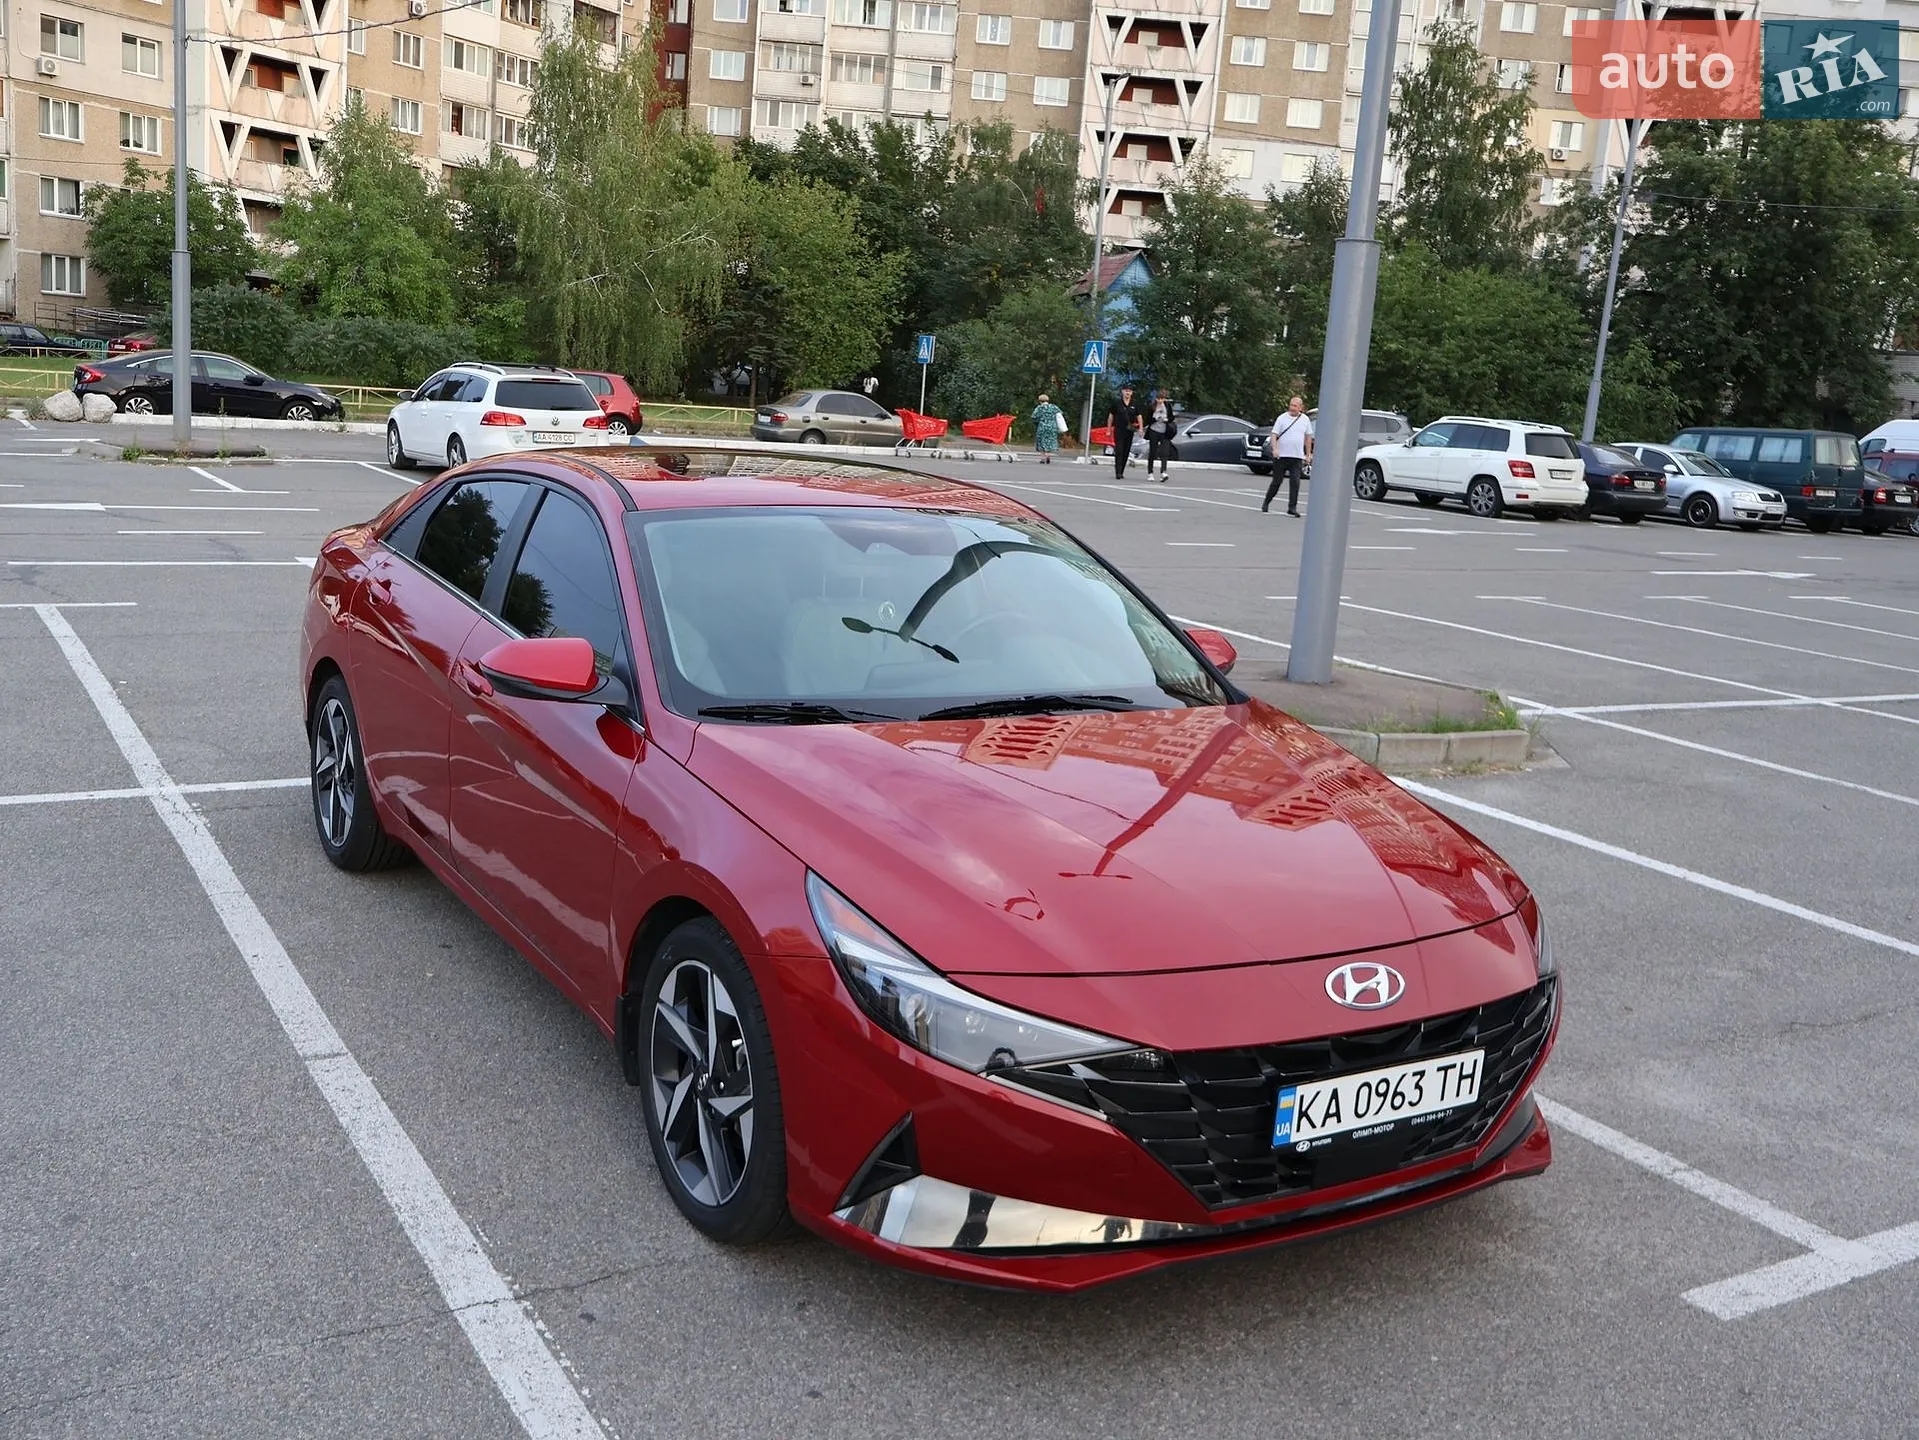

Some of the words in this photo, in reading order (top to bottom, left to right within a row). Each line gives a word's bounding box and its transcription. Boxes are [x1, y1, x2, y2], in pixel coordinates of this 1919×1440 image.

[1295, 1087, 1342, 1133] KA
[1353, 1070, 1427, 1119] 0963
[1436, 1059, 1478, 1102] TH
[1276, 1124, 1291, 1137] UA
